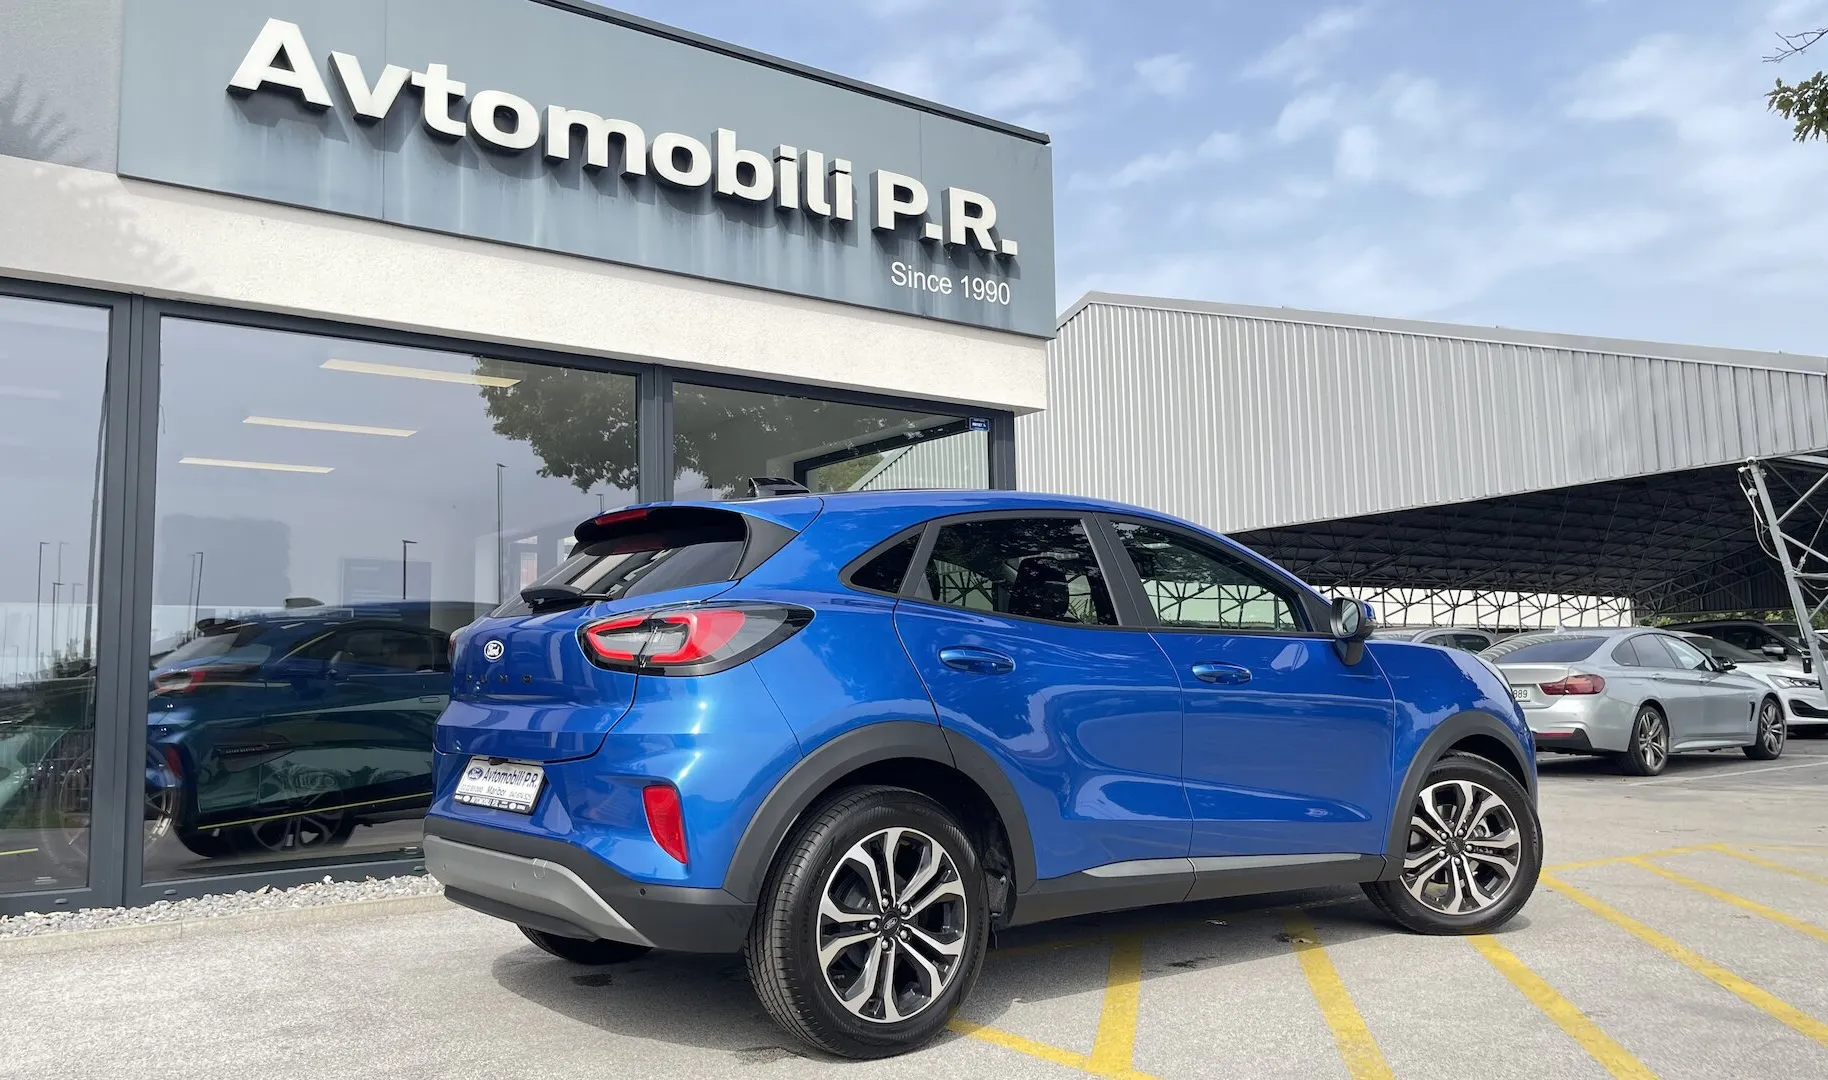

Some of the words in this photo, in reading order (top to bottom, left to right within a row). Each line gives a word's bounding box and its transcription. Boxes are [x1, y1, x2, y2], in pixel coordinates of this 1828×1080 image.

[228, 18, 854, 222] Avtomobili
[870, 169, 1018, 257] P.R.
[891, 261, 952, 295] Since
[960, 275, 1010, 305] 1990
